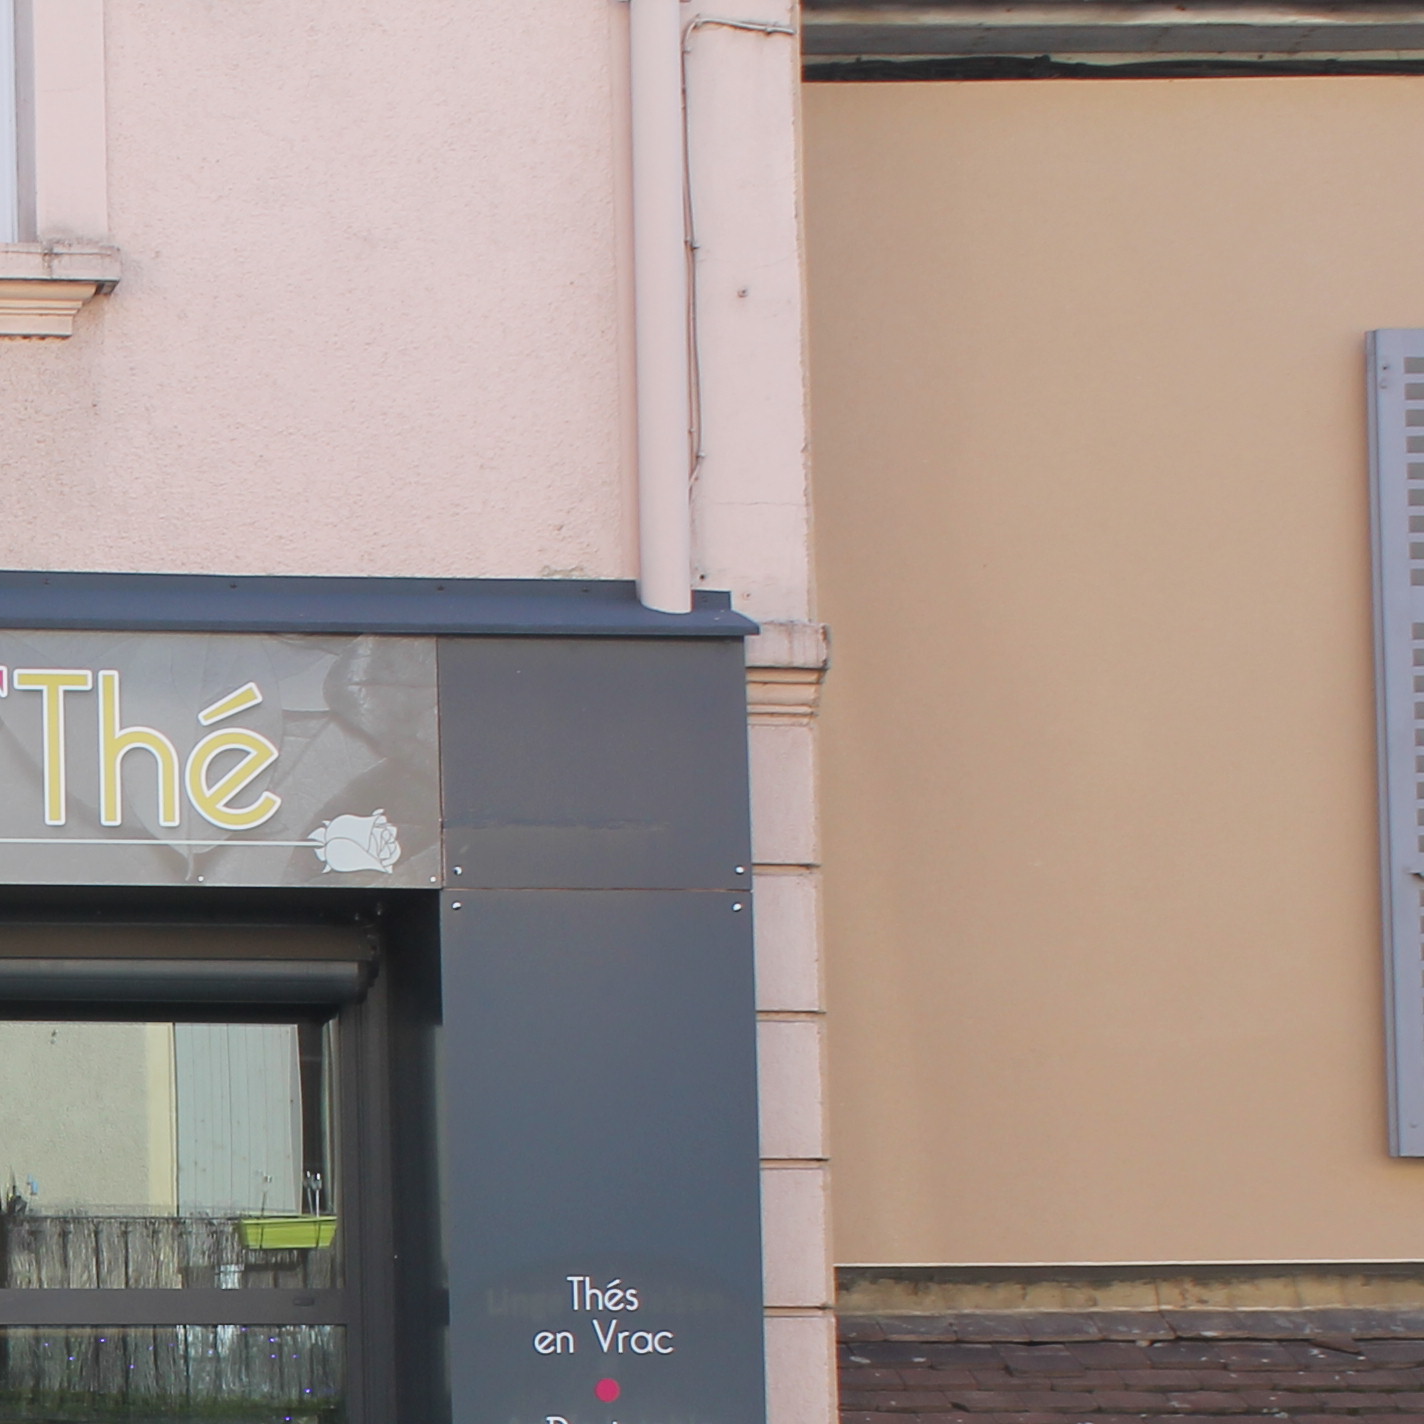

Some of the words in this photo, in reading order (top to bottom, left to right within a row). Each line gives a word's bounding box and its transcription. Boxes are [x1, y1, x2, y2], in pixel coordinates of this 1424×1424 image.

[567, 1276, 639, 1312] Thés
[534, 1329, 574, 1355] en
[592, 1319, 674, 1355] Vrac
